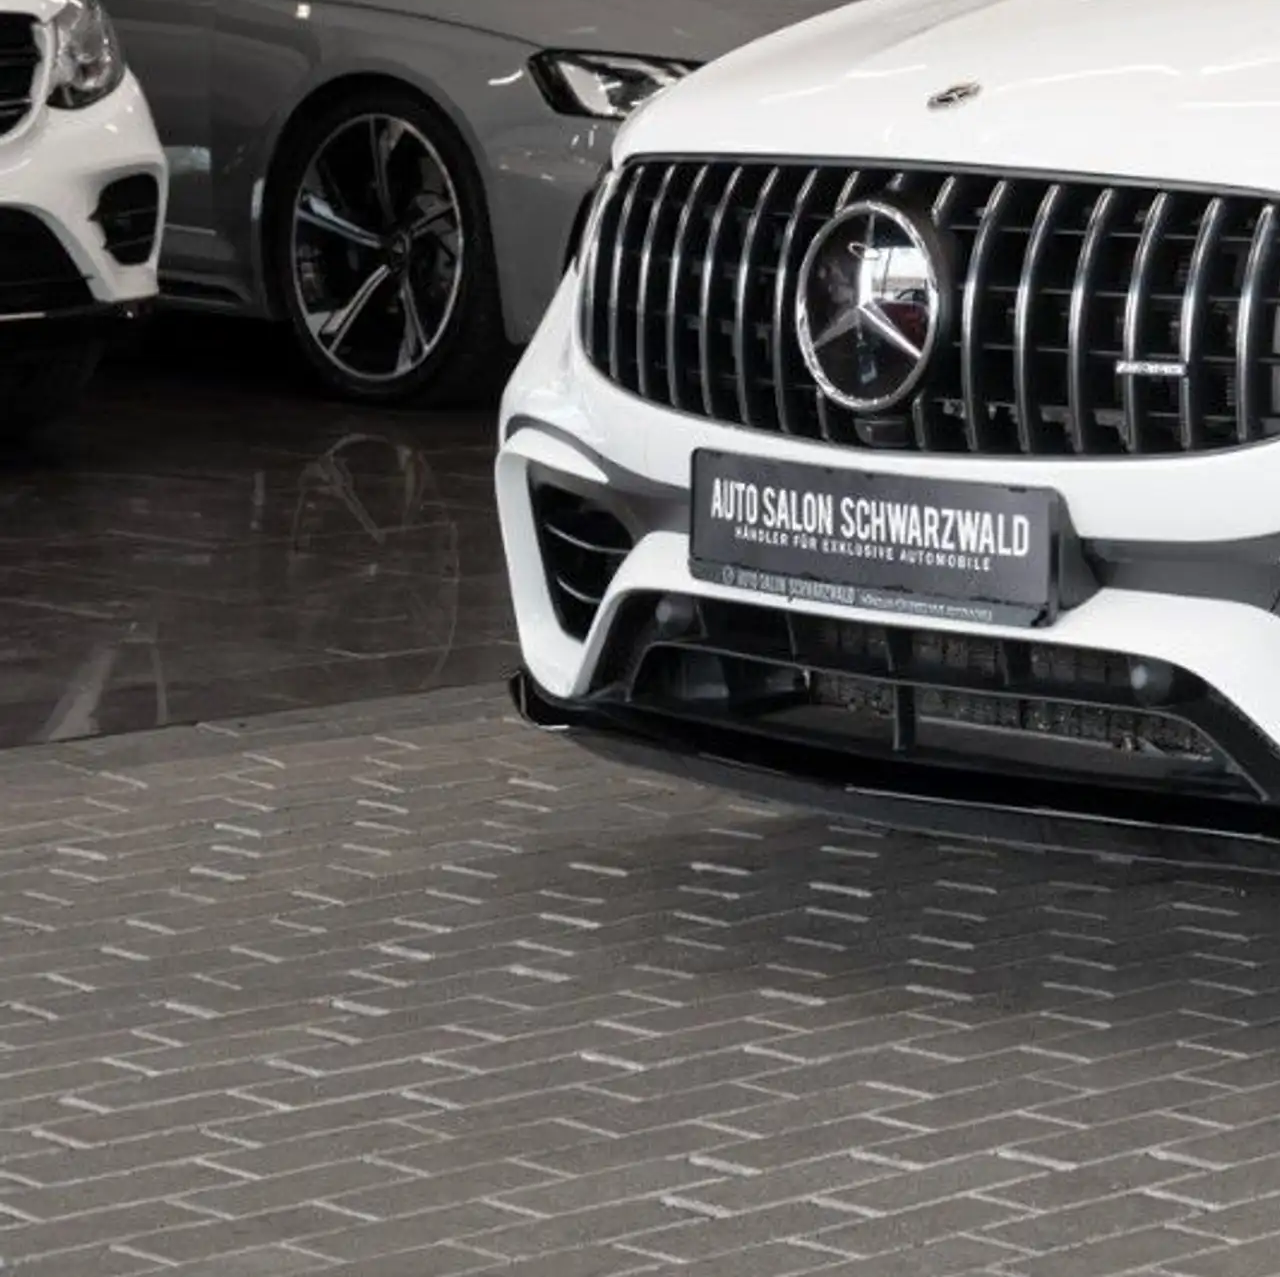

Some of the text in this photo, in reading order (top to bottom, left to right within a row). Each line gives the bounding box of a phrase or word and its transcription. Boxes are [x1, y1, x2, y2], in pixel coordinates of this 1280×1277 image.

[710, 478, 1030, 557] AUTO SALON SCHWARZWALD
[734, 525, 991, 571] HÄNDLER FÜR EXKLUSIVE AUTOMOBILE
